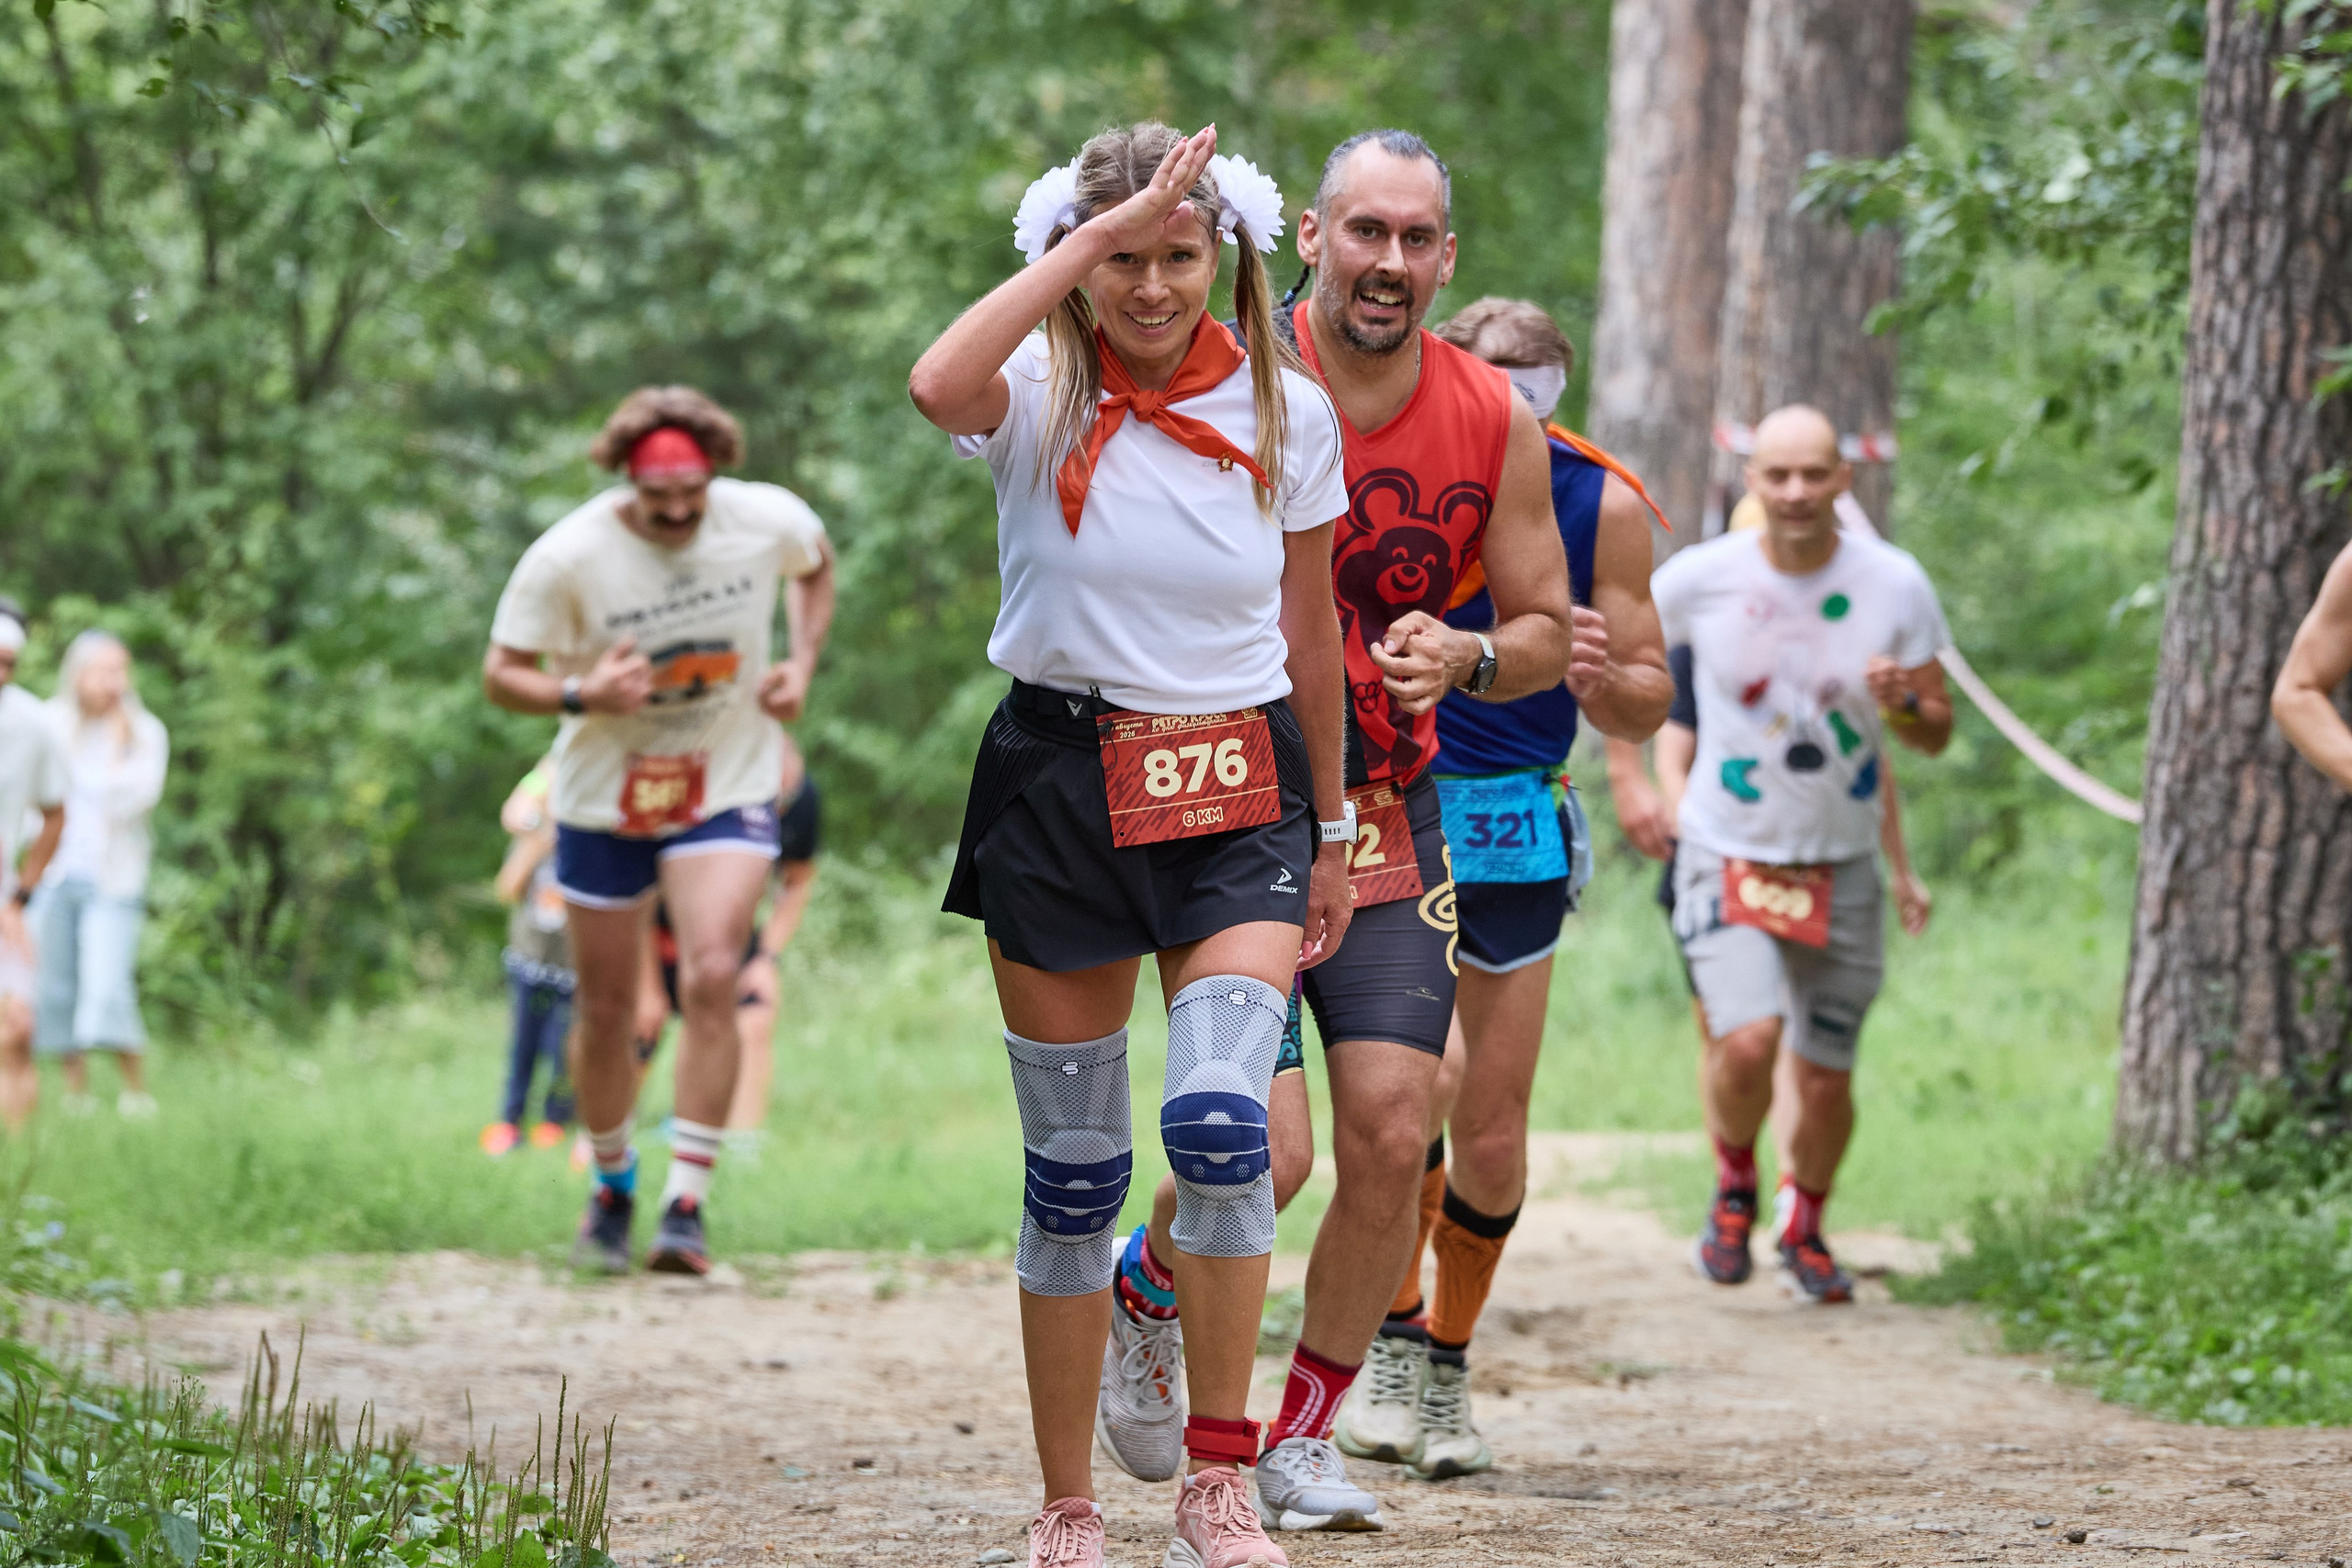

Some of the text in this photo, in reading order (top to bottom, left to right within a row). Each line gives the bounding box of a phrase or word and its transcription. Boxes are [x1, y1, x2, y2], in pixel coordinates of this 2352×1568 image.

[1143, 738, 1248, 798] 876
[1182, 811, 1196, 828] 6
[1462, 808, 1538, 849] 321
[1270, 884, 1298, 895] DEMIX
